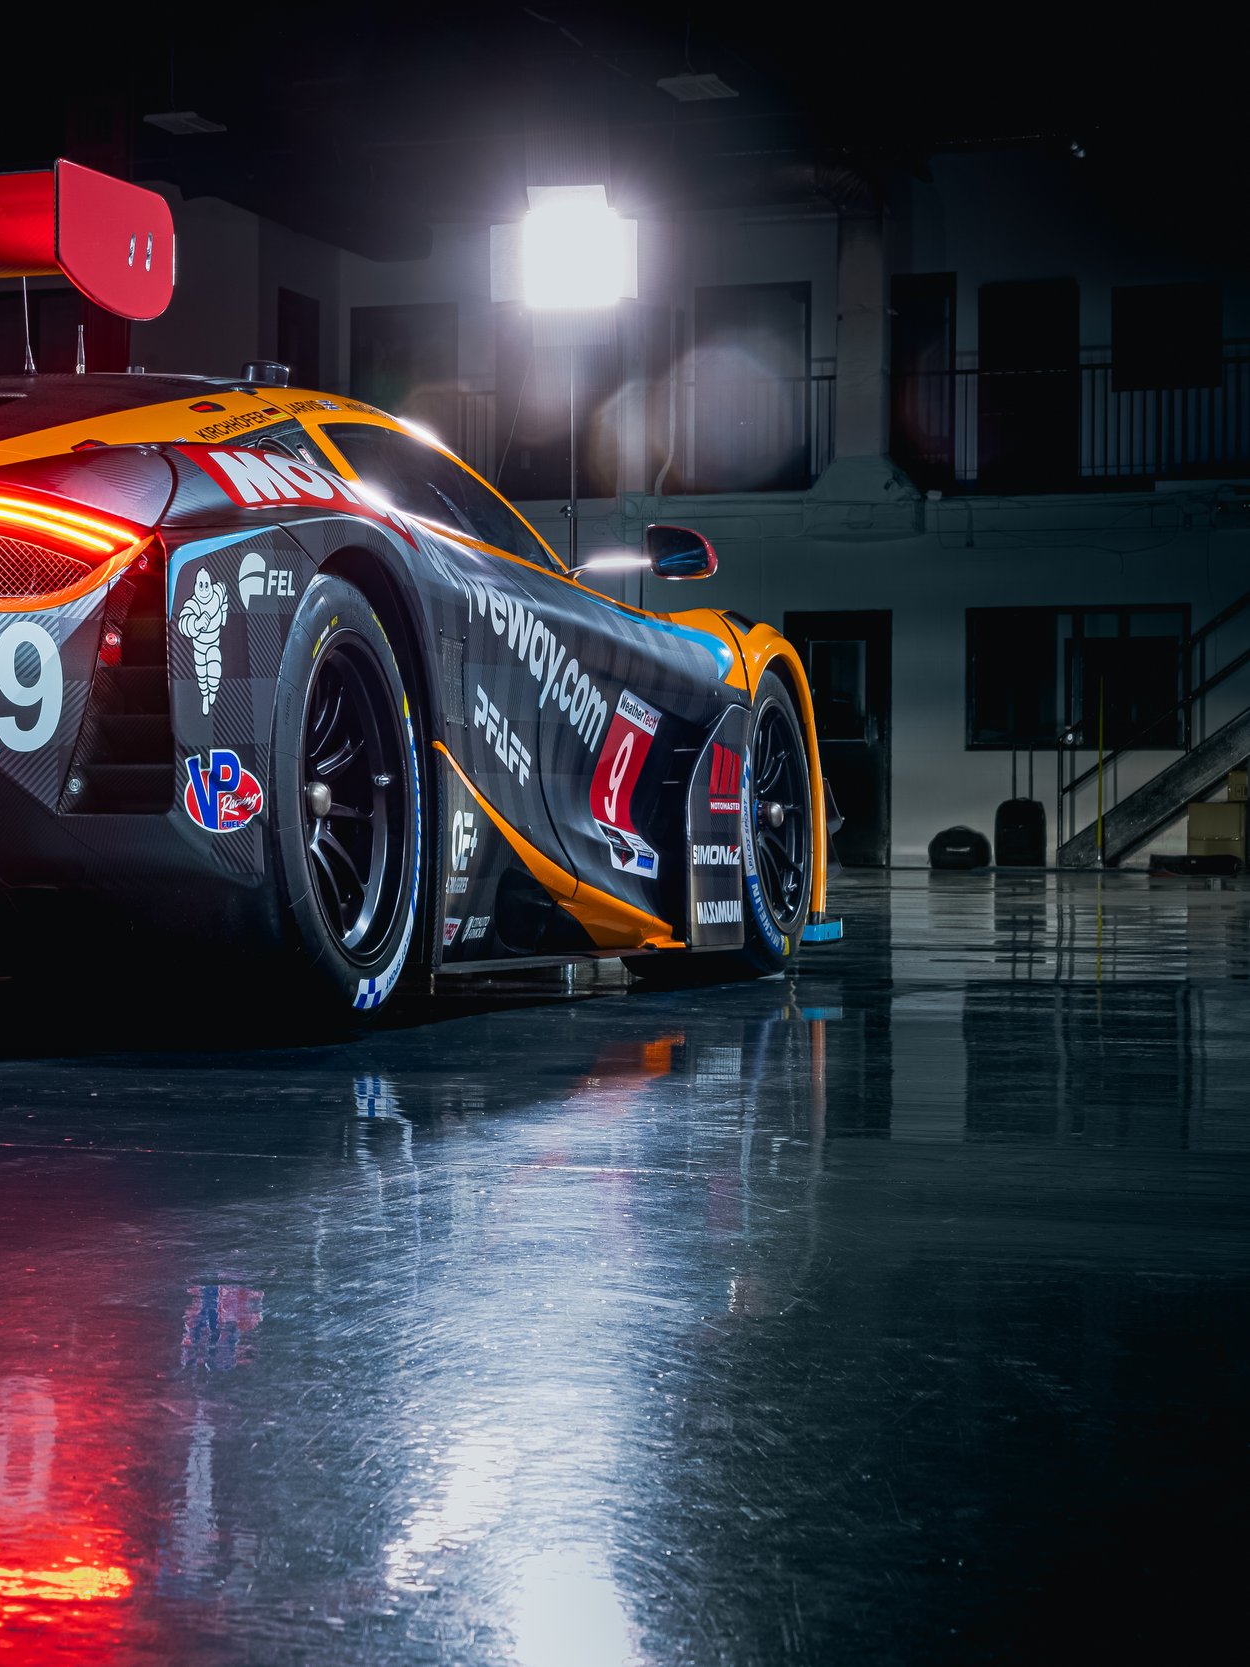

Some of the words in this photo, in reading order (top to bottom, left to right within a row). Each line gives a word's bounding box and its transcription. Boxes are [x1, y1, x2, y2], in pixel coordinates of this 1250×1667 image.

[285, 400, 325, 415] JARVIS
[194, 411, 271, 441] KIRCHHÖFER
[209, 451, 407, 534] MOT
[267, 570, 295, 597] FEL
[430, 548, 608, 753] veway.com
[474, 684, 531, 787] PFAFF
[185, 750, 241, 831] VP
[604, 732, 634, 823] 9
[221, 792, 261, 820] Racing
[710, 802, 740, 811] MOTOMASTER
[221, 820, 247, 829] FUELS
